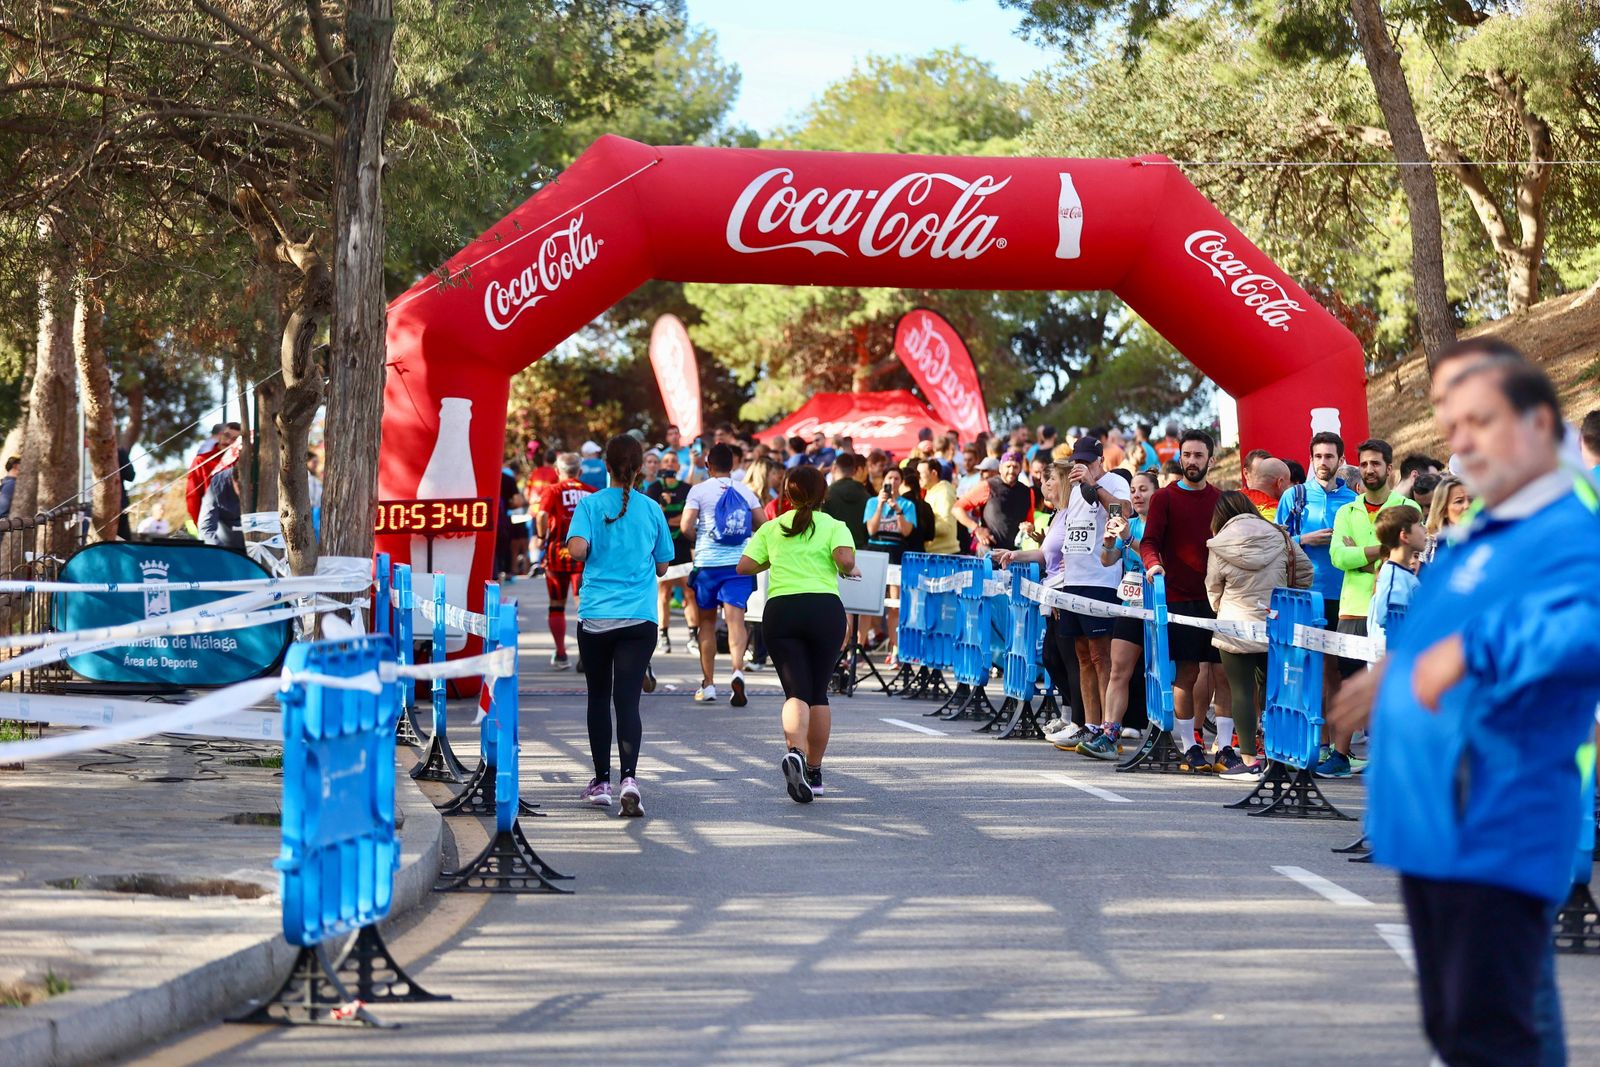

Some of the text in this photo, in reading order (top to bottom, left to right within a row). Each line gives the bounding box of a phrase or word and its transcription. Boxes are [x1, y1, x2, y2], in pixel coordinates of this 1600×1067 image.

[726, 167, 1012, 260] Coca-Cola
[484, 211, 601, 331] Coca-Cola
[1184, 229, 1307, 330] Coca-Cola
[1069, 530, 1088, 542] 439
[1123, 585, 1141, 598] 694
[172, 635, 188, 649] de
[190, 635, 238, 652] Málaga
[124, 655, 198, 670] Área de Deporte
